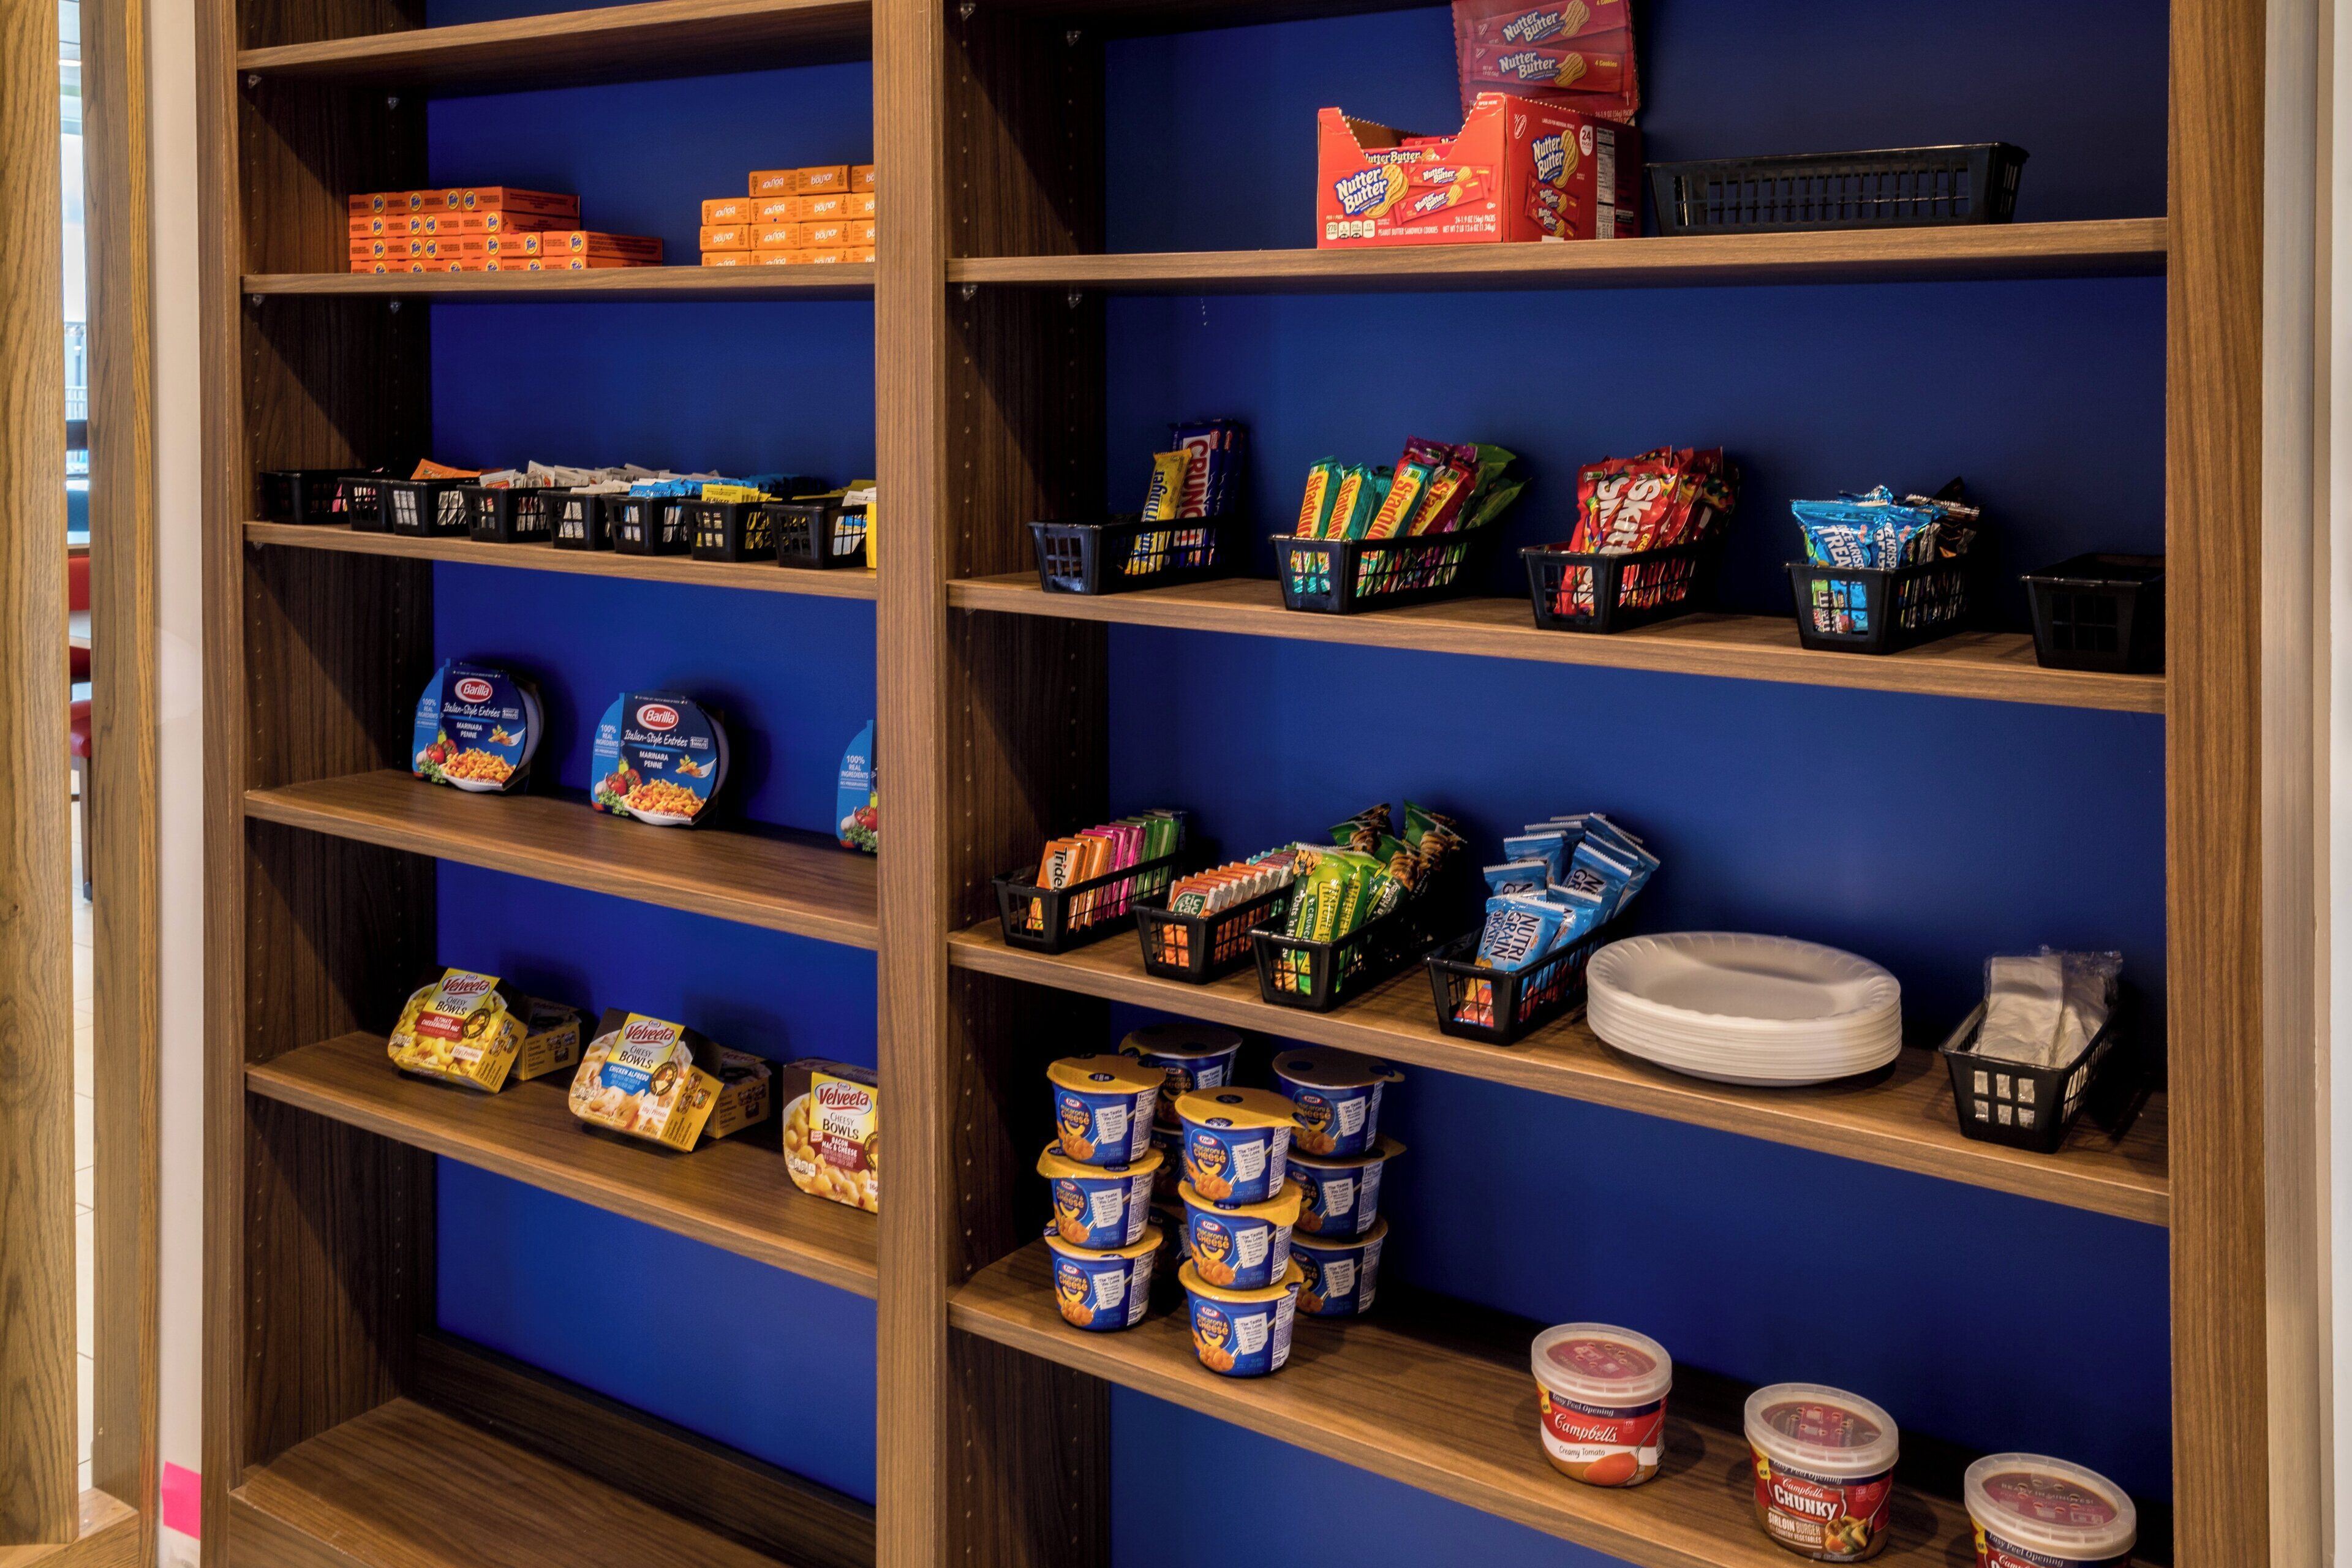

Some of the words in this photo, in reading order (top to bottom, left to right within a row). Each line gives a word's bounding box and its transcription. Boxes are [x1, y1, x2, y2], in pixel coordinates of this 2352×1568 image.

[1503, 12, 1538, 42] Nutter
[1523, 12, 1558, 42] Butter
[1499, 53, 1536, 73] Nutter
[1519, 59, 1555, 78] Butter
[1581, 130, 1591, 140] 24
[1532, 136, 1561, 162] Nutter
[1390, 151, 1421, 162] Butter
[1537, 151, 1564, 180] Butter
[811, 173, 832, 185] bounce
[1336, 168, 1381, 200] Nutter
[374, 198, 383, 209] Tide
[411, 196, 420, 208] Tide
[448, 194, 458, 206] Tide
[1343, 179, 1387, 214] Butter
[814, 201, 836, 213] bounce
[373, 221, 382, 232] Tide
[411, 219, 420, 230] Tide
[488, 217, 498, 228] Tide
[714, 232, 734, 243] bounce
[815, 228, 837, 240] bounce
[374, 243, 383, 255] Tide
[412, 242, 421, 254] Tide
[488, 240, 497, 252] Tide
[526, 239, 536, 251] Tide
[571, 237, 582, 249] Tide
[1817, 525, 1852, 567] TREA
[463, 684, 489, 697] Barilla
[443, 703, 477, 718] Italian-Style
[478, 706, 500, 718] Entrées
[646, 710, 675, 724] Barilla
[456, 722, 482, 731] MARINARA
[601, 725, 616, 733] 100%
[624, 729, 662, 748] Italian-Style
[664, 734, 688, 747] Entrées
[639, 751, 668, 761] MARINARA
[846, 755, 865, 764] 100%
[644, 761, 663, 769] PENNE
[841, 770, 869, 778] INGREDIENTS
[1183, 894, 1202, 908] tic
[1379, 881, 1400, 907] Honey
[1178, 903, 1199, 915] tac
[1290, 895, 1303, 916] Oats
[1303, 908, 1314, 939] CRUNC
[1490, 911, 1521, 961] GRAIN
[1507, 913, 1541, 963] NUTRI
[442, 978, 490, 992] Velveeta
[447, 997, 467, 1005] CHEESY
[435, 1001, 467, 1016] BOWLS
[625, 1025, 675, 1040] Velveeta
[630, 1045, 653, 1057] CHEESY
[619, 1051, 653, 1069] BOWLS
[609, 1066, 628, 1075] CHICKEN
[628, 1070, 649, 1081] ALFREDO
[819, 1087, 870, 1106] Velveeta
[830, 1112, 855, 1127] CHEESY
[823, 1118, 859, 1139] BOWLS
[822, 1140, 832, 1150] MAC
[838, 1145, 858, 1157] CHEESE
[832, 1137, 848, 1147] BACON
[1551, 1393, 1566, 1405] Easy
[1567, 1399, 1581, 1411] Peel
[1582, 1404, 1615, 1417] Opening
[1554, 1412, 1618, 1443] Campbell's
[1559, 1445, 1580, 1458] Creamy
[1782, 1477, 1823, 1499] Campbell's
[1774, 1484, 1838, 1521] CHUNKY
[1768, 1512, 1795, 1532] SIRLOIN
[1796, 1519, 1821, 1536] BURGER
[1794, 1533, 1822, 1544] VEGETABLES
[1989, 1532, 2005, 1547] Easy
[2007, 1542, 2023, 1555] Peel
[2026, 1551, 2064, 1567] Opening
